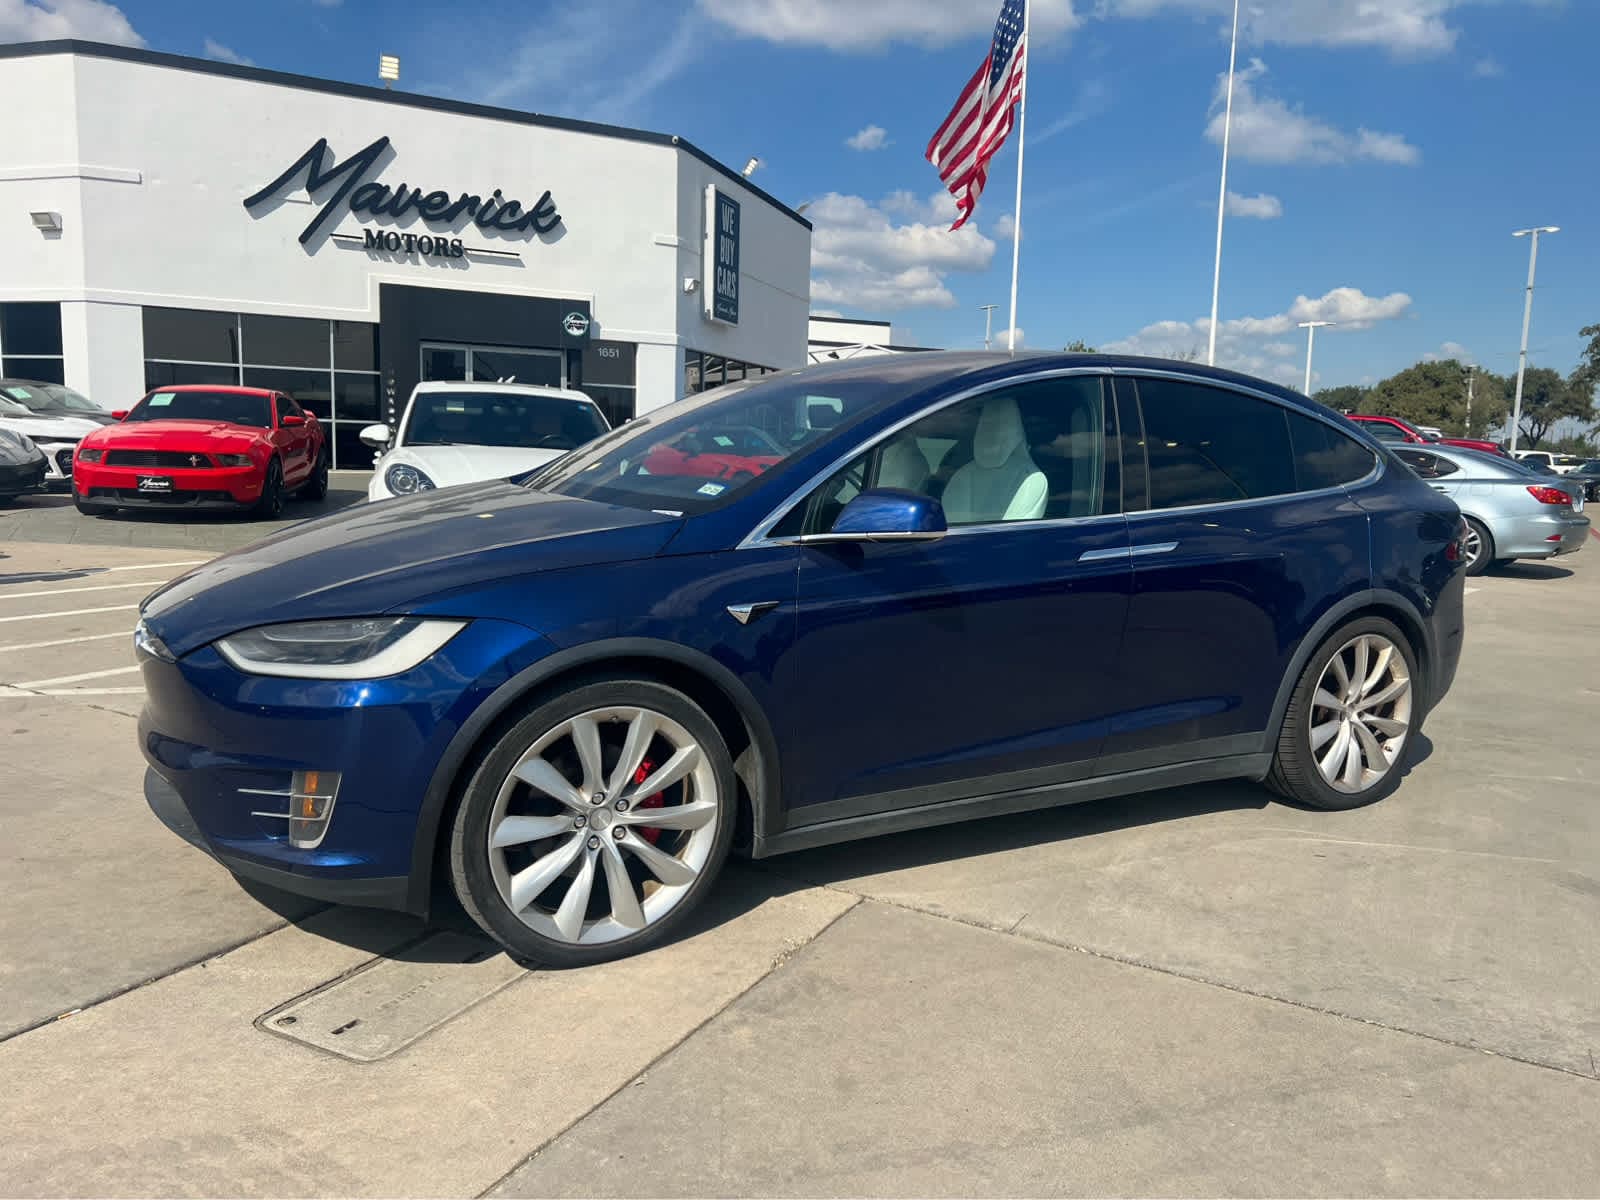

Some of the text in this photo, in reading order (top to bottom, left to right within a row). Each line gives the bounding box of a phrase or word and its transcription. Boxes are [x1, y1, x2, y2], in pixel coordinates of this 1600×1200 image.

[243, 135, 562, 245] Maverick
[721, 203, 735, 235] WE
[363, 228, 465, 259] MOTORS
[720, 234, 735, 266] BUY
[717, 265, 737, 299] CARS
[597, 347, 620, 358] 1651
